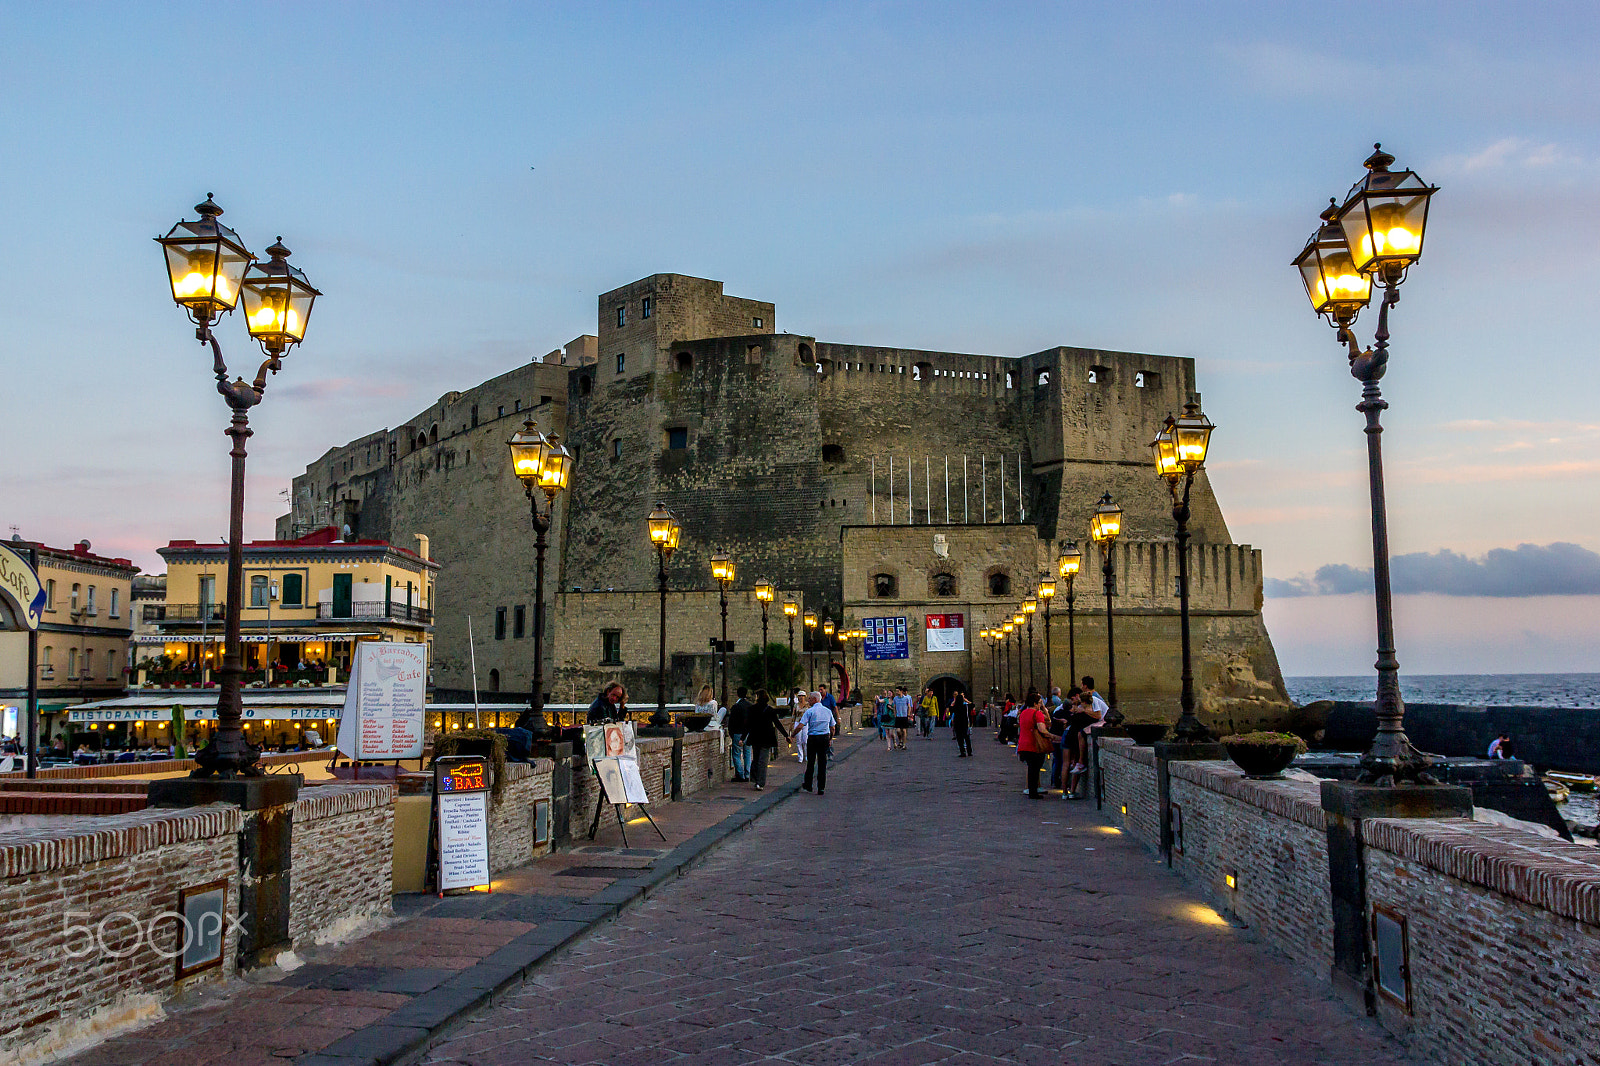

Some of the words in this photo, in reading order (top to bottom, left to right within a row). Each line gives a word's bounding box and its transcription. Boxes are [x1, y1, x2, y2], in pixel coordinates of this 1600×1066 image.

[72, 710, 159, 720] RISTORANTE
[291, 709, 340, 718] PIZZERI
[454, 776, 485, 790] BAR
